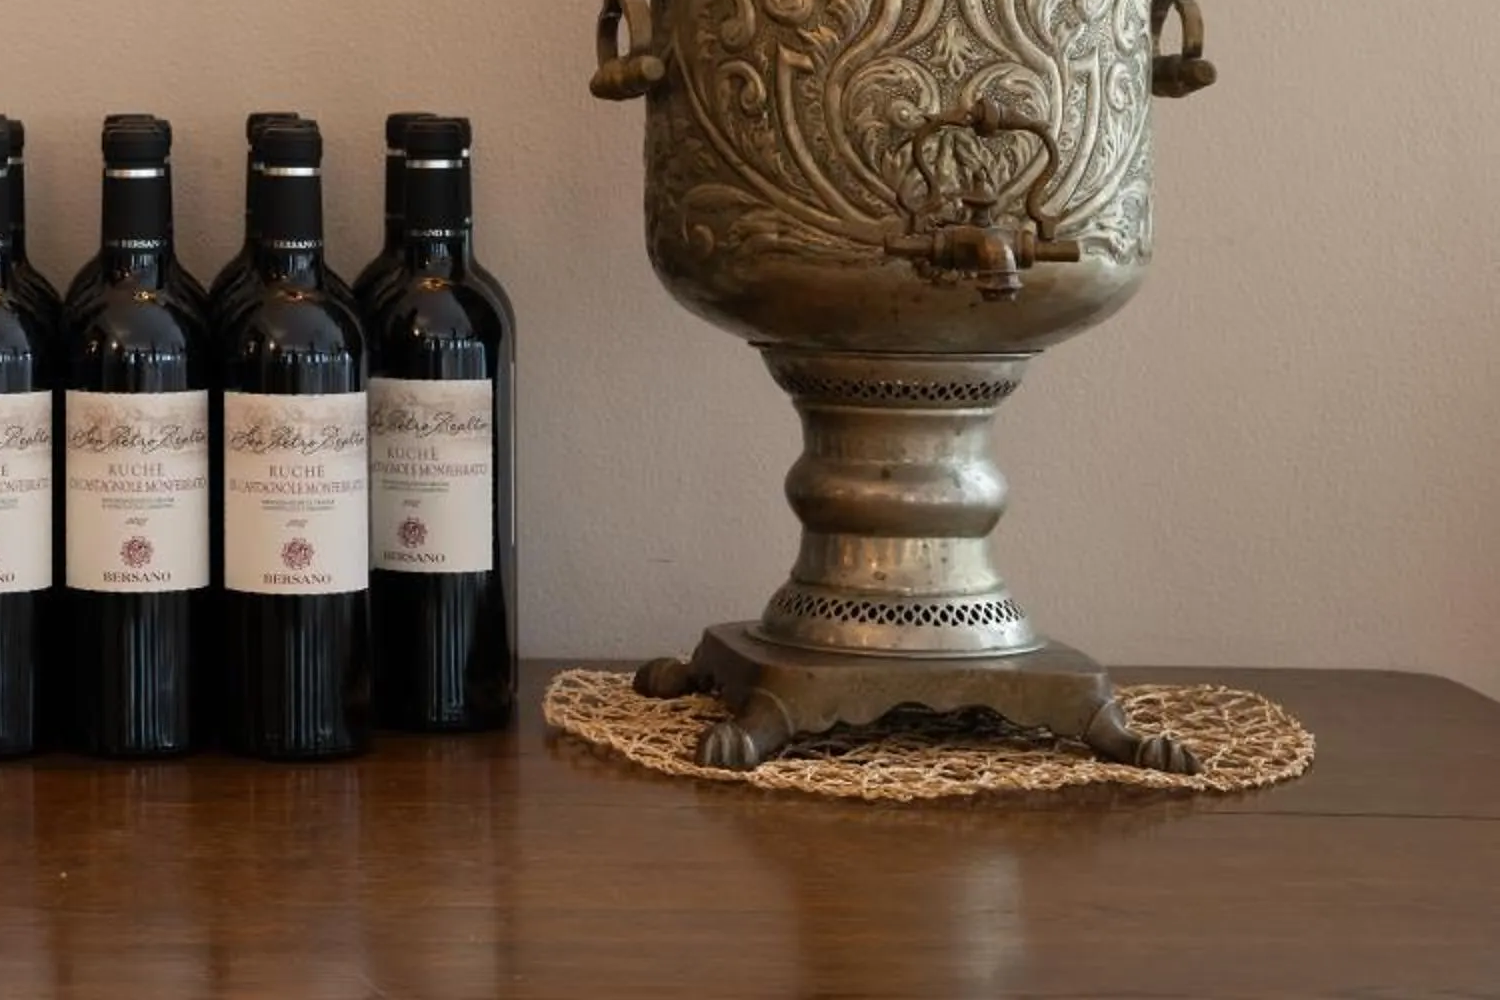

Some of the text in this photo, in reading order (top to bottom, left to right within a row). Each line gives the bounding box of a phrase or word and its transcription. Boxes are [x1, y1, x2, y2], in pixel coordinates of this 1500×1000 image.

[384, 551, 446, 563] BERSANO
[103, 571, 171, 583] BERSANO
[263, 573, 331, 585] BERSANO
